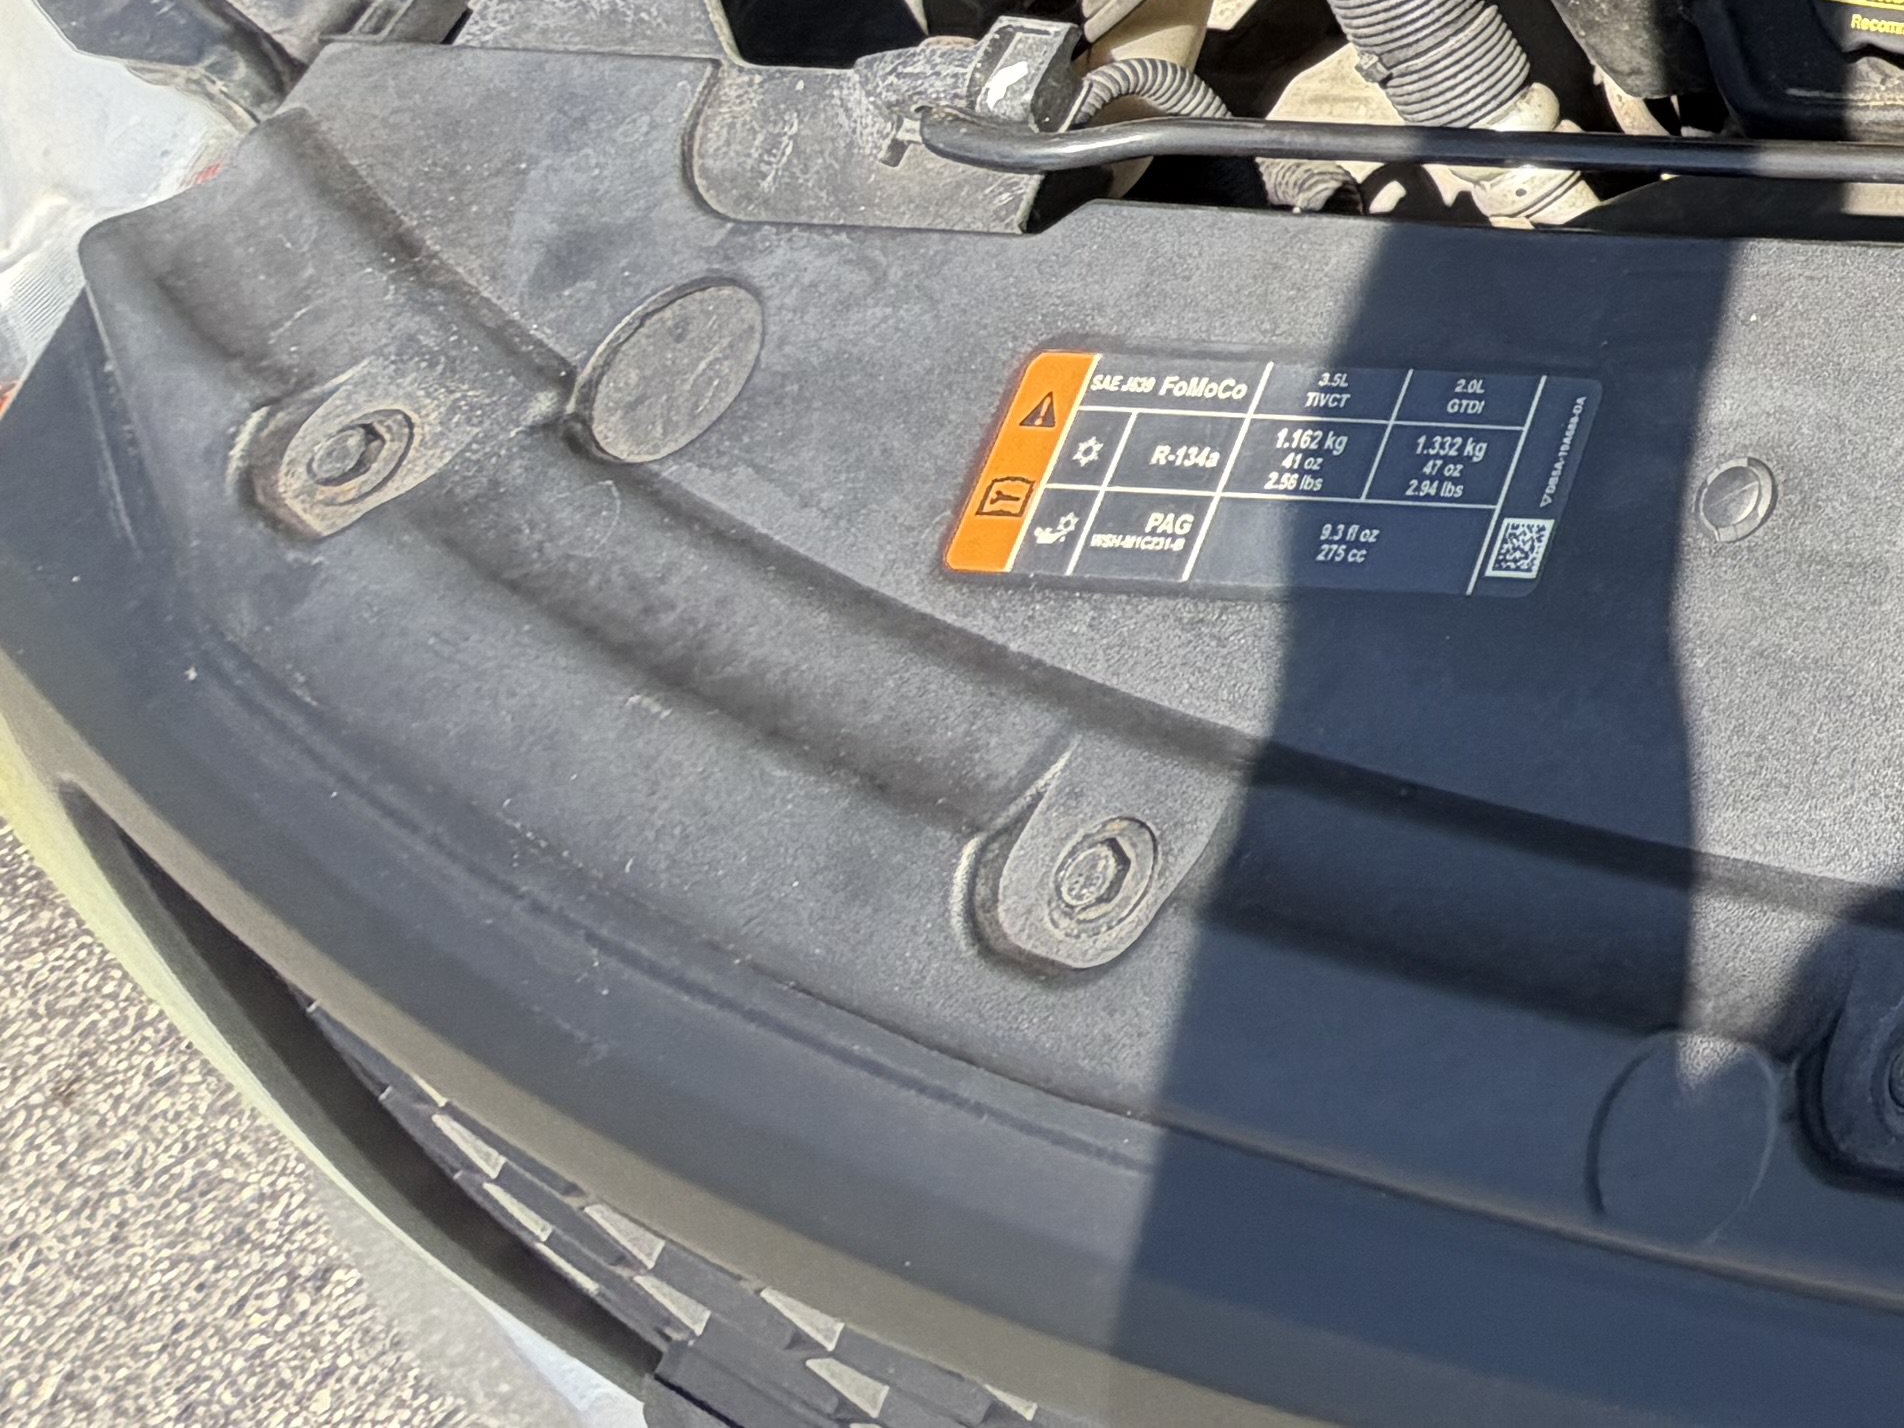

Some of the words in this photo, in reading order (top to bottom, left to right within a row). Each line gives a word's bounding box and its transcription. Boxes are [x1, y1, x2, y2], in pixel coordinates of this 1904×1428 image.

[1090, 375, 1123, 391] SAE
[1159, 376, 1248, 400] FoMoCo
[1318, 372, 1349, 387] 3.5L
[1454, 379, 1485, 394] 2.0L
[1447, 399, 1485, 415] GTDI
[1275, 428, 1322, 450] 1.162
[1323, 430, 1349, 455] kg
[1415, 435, 1463, 456] 1.332
[1463, 437, 1487, 462] kg
[1149, 445, 1220, 468] R-134a
[1281, 453, 1301, 469] 41
[1303, 456, 1324, 470] oz
[1422, 460, 1442, 476] 47
[1443, 464, 1463, 477] oz
[1263, 473, 1297, 491] 2.56
[1299, 475, 1323, 492] lbs
[1405, 480, 1438, 497] 2.94
[1440, 482, 1463, 497] lbs
[1145, 513, 1195, 536] PAG
[1319, 524, 1344, 541] 9.3
[1346, 524, 1359, 541] fl
[1359, 528, 1380, 542] oz
[1316, 544, 1346, 562] 275
[1347, 548, 1368, 563] cc
